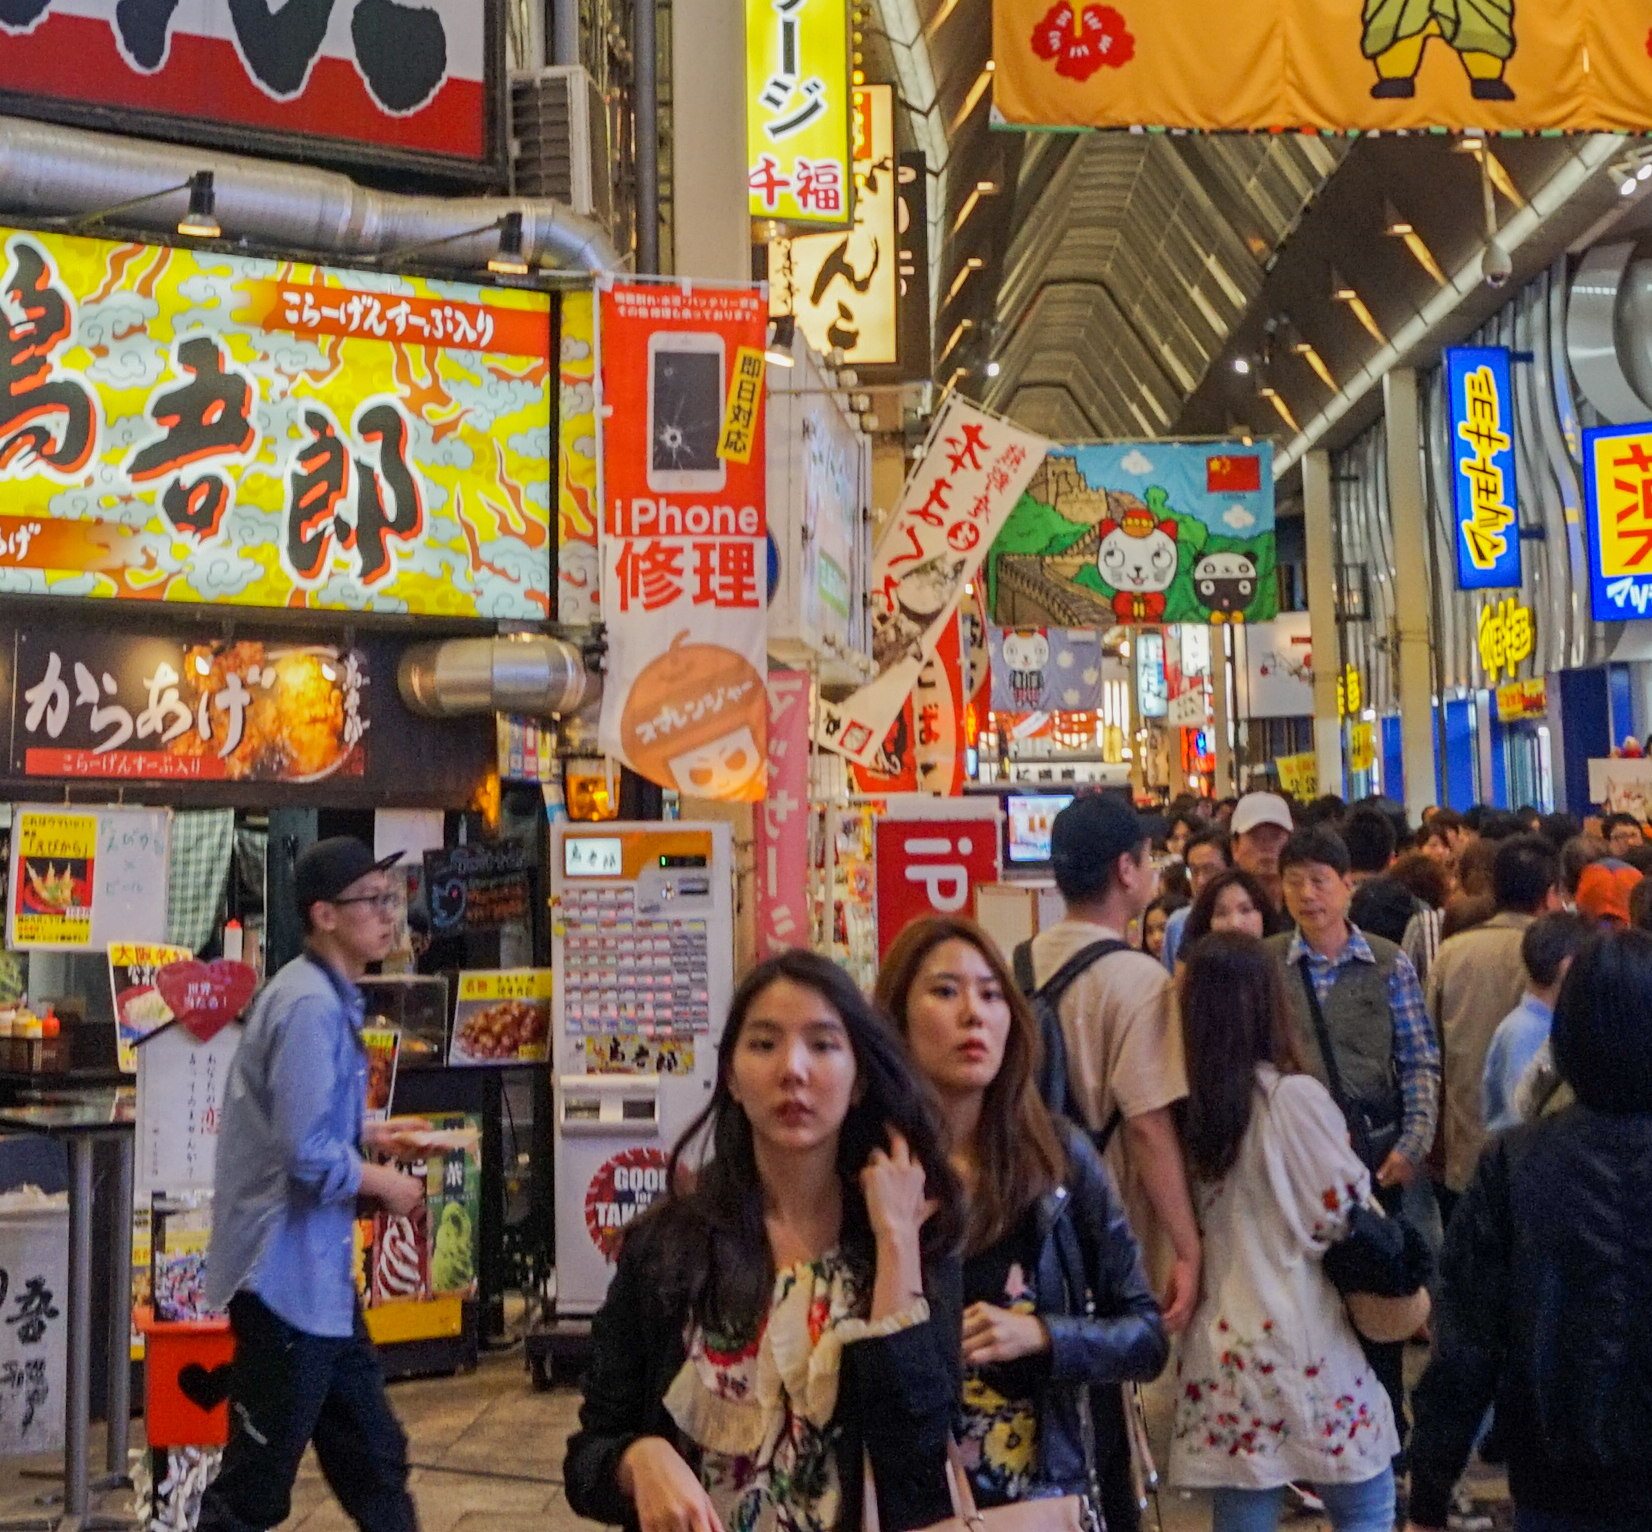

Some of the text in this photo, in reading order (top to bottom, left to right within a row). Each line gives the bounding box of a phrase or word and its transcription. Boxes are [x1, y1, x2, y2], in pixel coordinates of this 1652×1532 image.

[747, 157, 840, 211] 千福
[282, 290, 494, 348] こらーげんすーぷ入り
[723, 354, 763, 455] 即日対応
[1462, 367, 1511, 566] マツモトキヨシ
[614, 499, 759, 534] iPhone
[615, 540, 759, 612] 修理
[25, 651, 278, 759] からあげ
